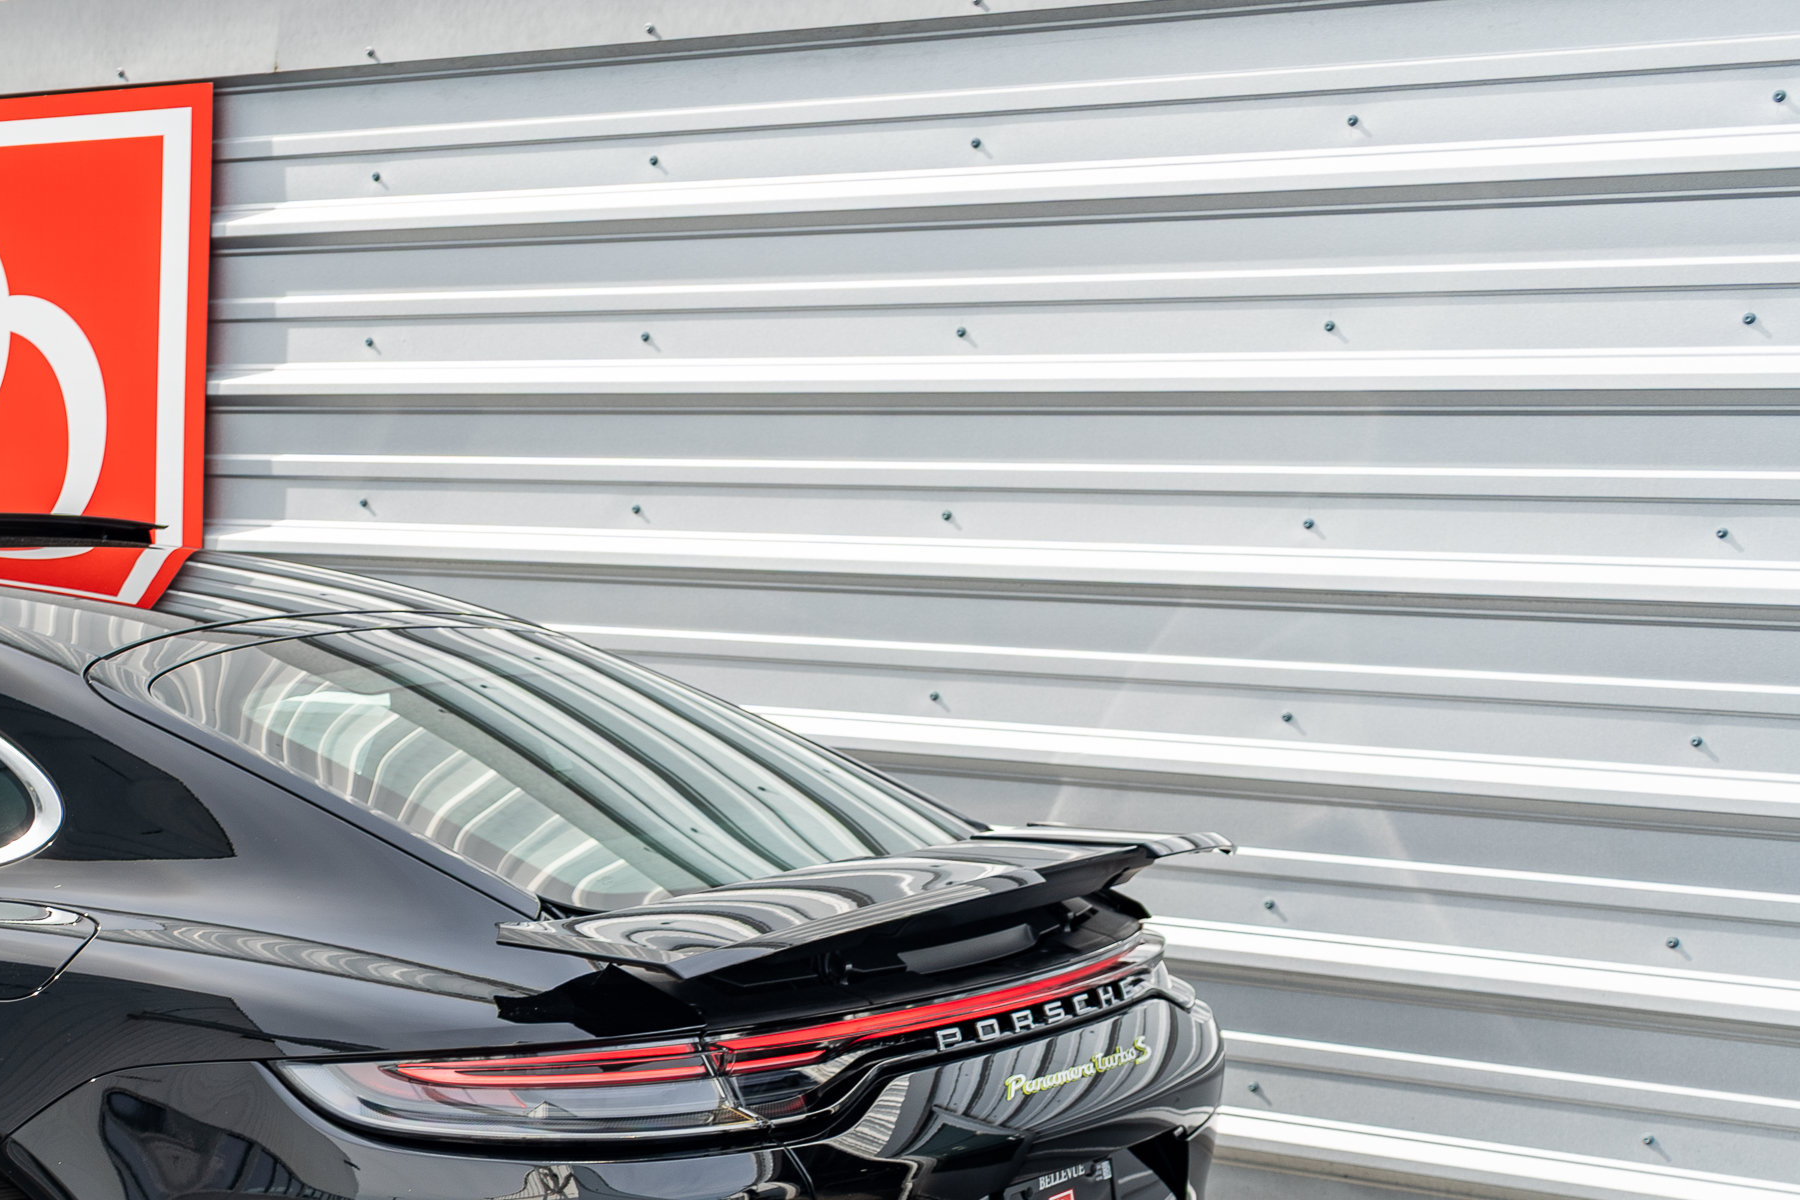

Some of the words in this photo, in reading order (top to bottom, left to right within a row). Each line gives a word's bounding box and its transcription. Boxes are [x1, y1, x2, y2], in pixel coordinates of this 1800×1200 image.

[935, 976, 1137, 1051] PORSCHE
[1004, 1065, 1096, 1101] Panamera
[1133, 1035, 1152, 1065] S
[1038, 1164, 1086, 1191] BELLEVUE
